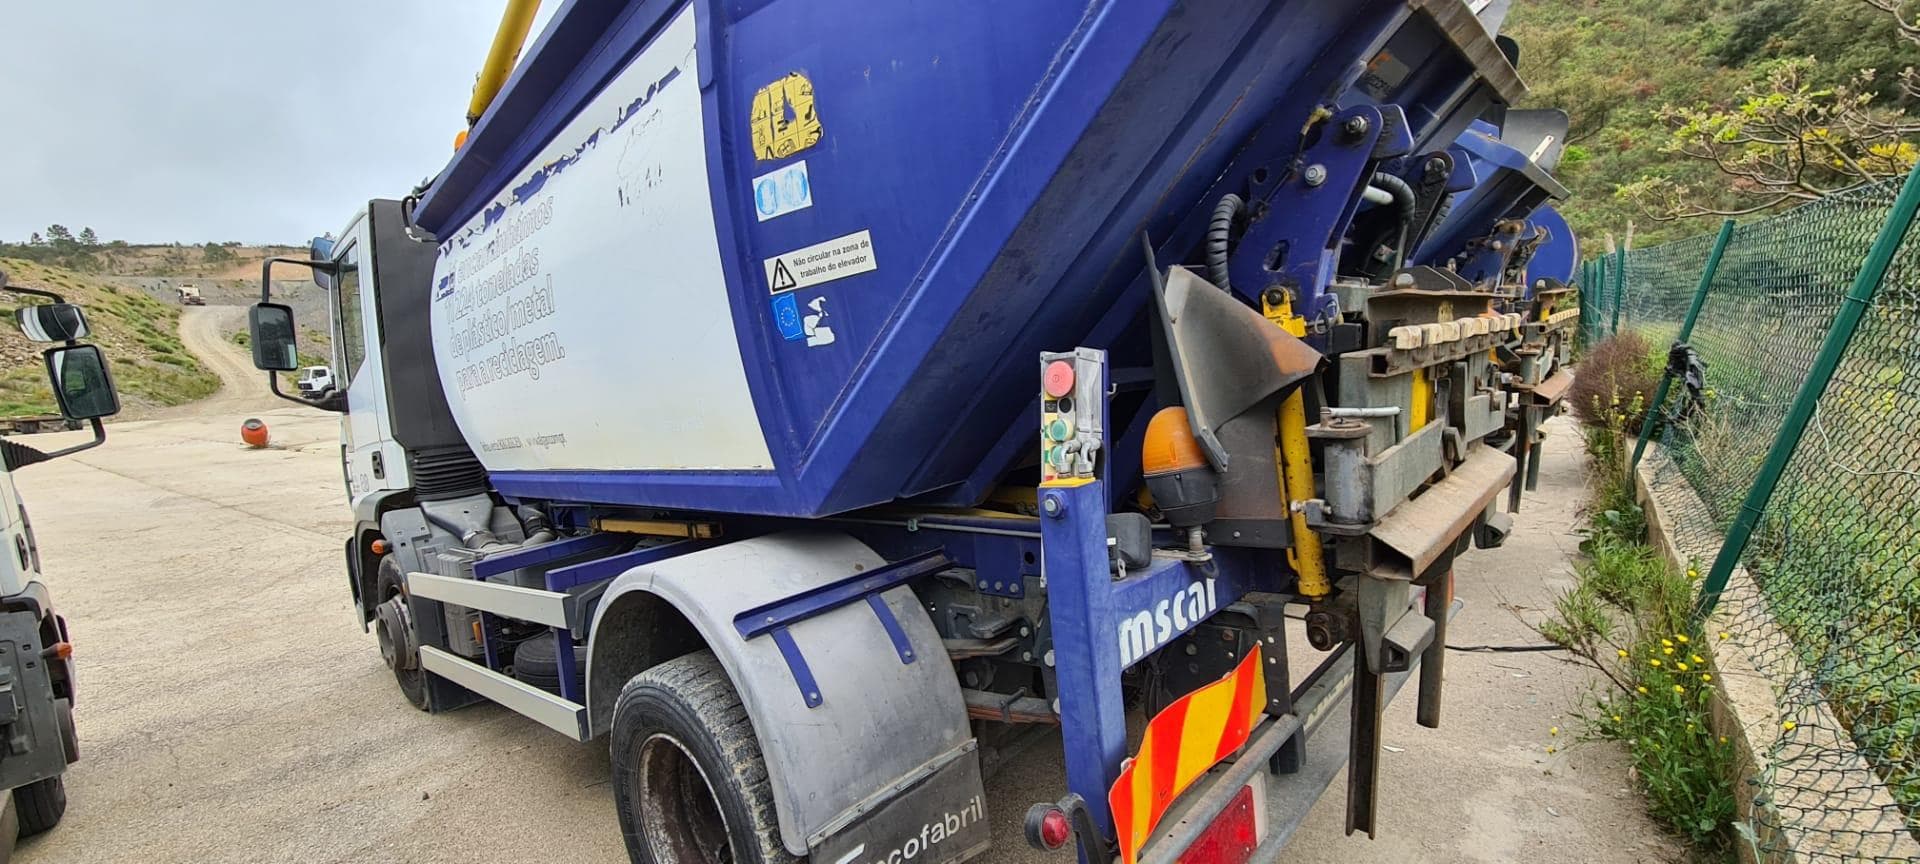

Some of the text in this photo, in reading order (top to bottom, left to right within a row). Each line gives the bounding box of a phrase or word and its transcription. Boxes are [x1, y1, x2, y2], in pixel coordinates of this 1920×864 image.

[793, 240, 869, 267] Não circular na zona de
[800, 255, 867, 278] trabalho do elevador
